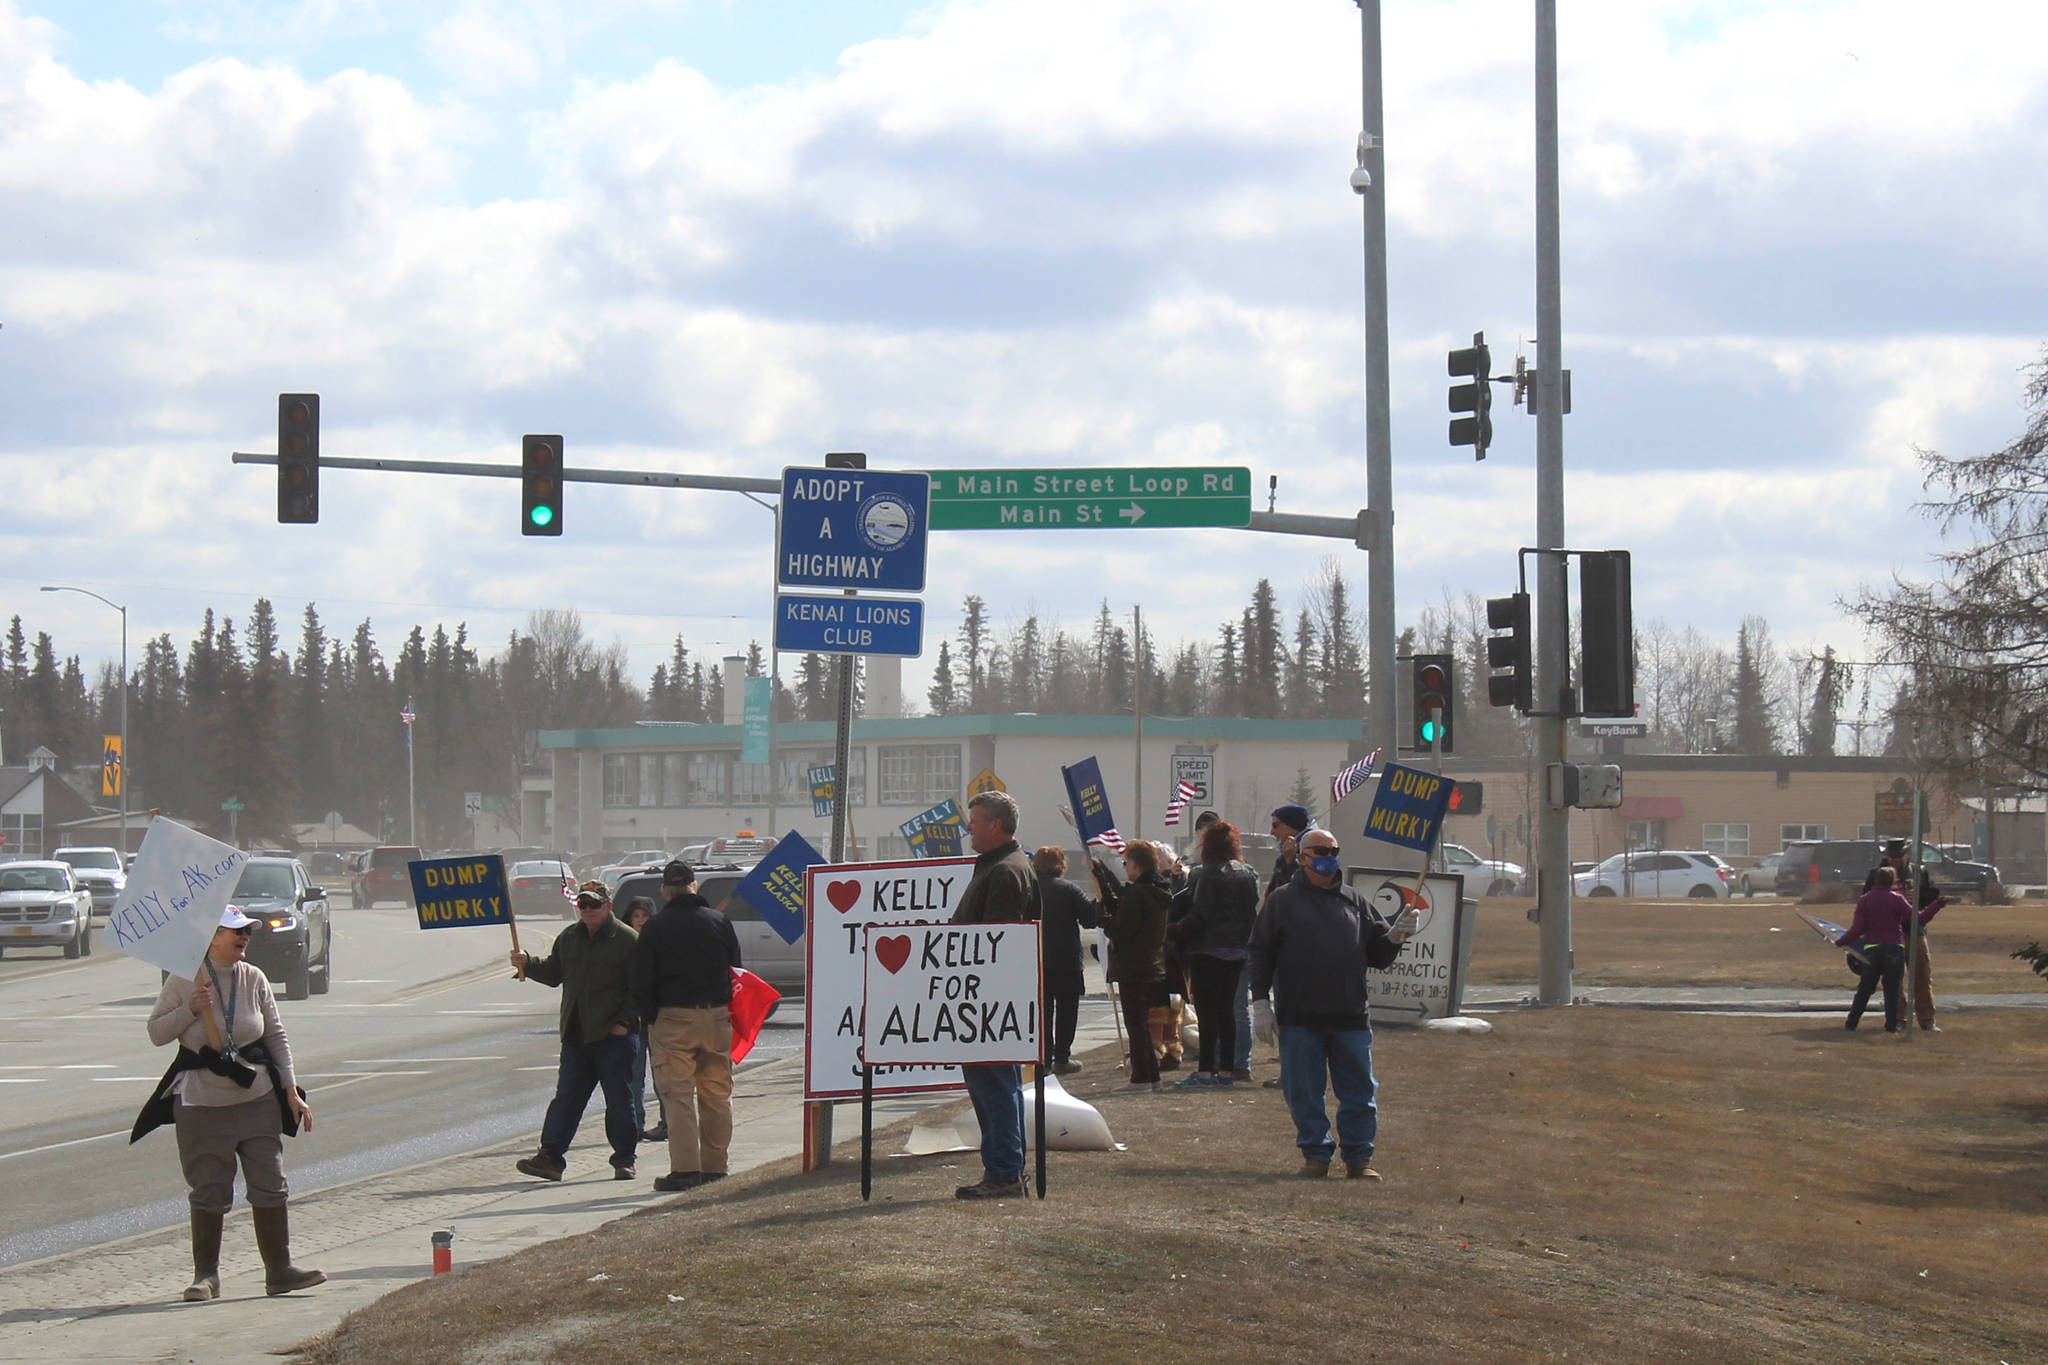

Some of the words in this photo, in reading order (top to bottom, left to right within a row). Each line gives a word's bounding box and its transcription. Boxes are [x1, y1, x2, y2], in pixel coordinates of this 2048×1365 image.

[793, 478, 864, 502] ADOPT
[957, 475, 1019, 494] Main
[1033, 475, 1114, 494] Street
[1129, 474, 1189, 496] Loop
[1203, 473, 1234, 492] Rd
[1000, 505, 1061, 523] Main
[1076, 505, 1103, 523] St
[819, 517, 833, 539] A
[788, 553, 884, 579] HIGHWAY
[787, 603, 844, 622] KENAI
[856, 606, 911, 626] LIONS
[823, 628, 873, 646] CLUB
[1593, 725, 1639, 737] KeyBank
[809, 767, 836, 785] KELL
[1176, 761, 1209, 770] SPEED
[1179, 771, 1205, 780] LIMIT
[1390, 769, 1440, 801] DUMP
[902, 801, 952, 837] KELLY
[1370, 807, 1432, 842] MURKY
[925, 824, 959, 840] KELLY
[424, 863, 489, 888] DUMP
[776, 864, 803, 892] KELL
[761, 880, 799, 914] ALASKA
[872, 876, 955, 913] KELLY
[110, 890, 171, 949] KELLY
[420, 895, 501, 923] MURKY
[920, 929, 1005, 971] KELLY
[1399, 941, 1436, 960] FIN
[928, 974, 981, 1001] FOR
[879, 1000, 1036, 1046] ALASKA!
